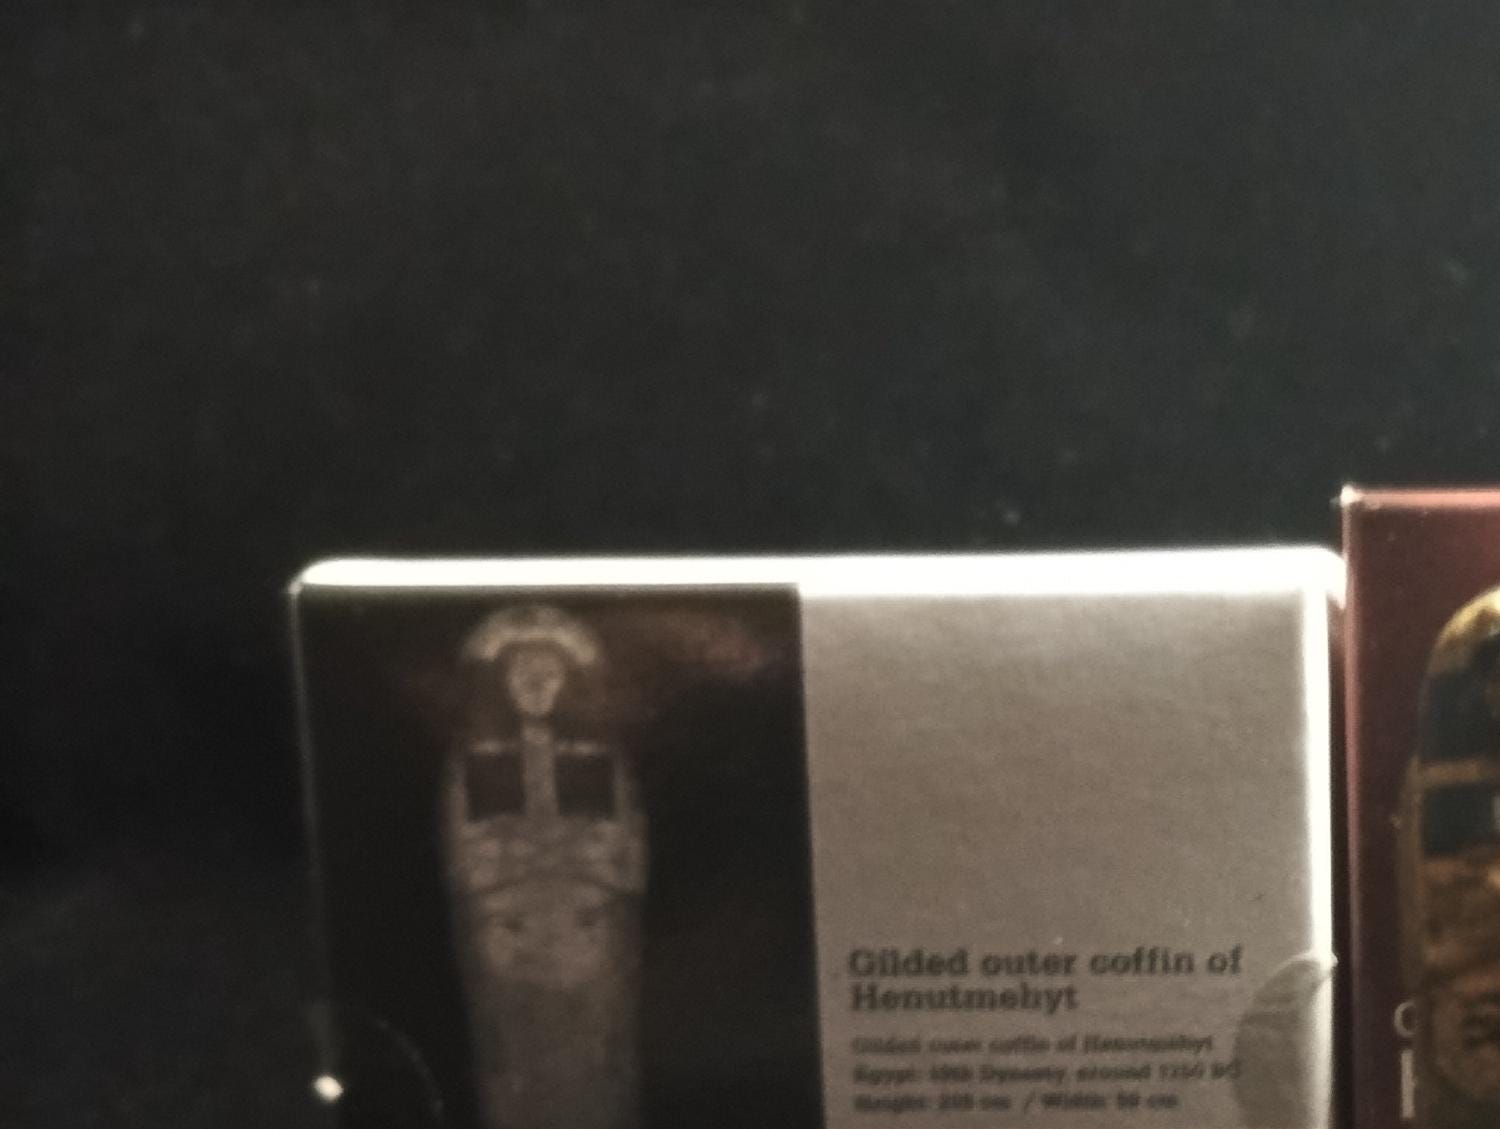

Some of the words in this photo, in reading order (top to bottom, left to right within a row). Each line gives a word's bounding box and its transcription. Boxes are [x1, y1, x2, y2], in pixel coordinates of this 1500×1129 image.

[848, 948, 968, 976] Gilded
[982, 950, 1077, 976] outer
[1089, 946, 1195, 975] coffin
[1207, 945, 1243, 975] of
[851, 983, 1078, 1014] Henutmehyt
